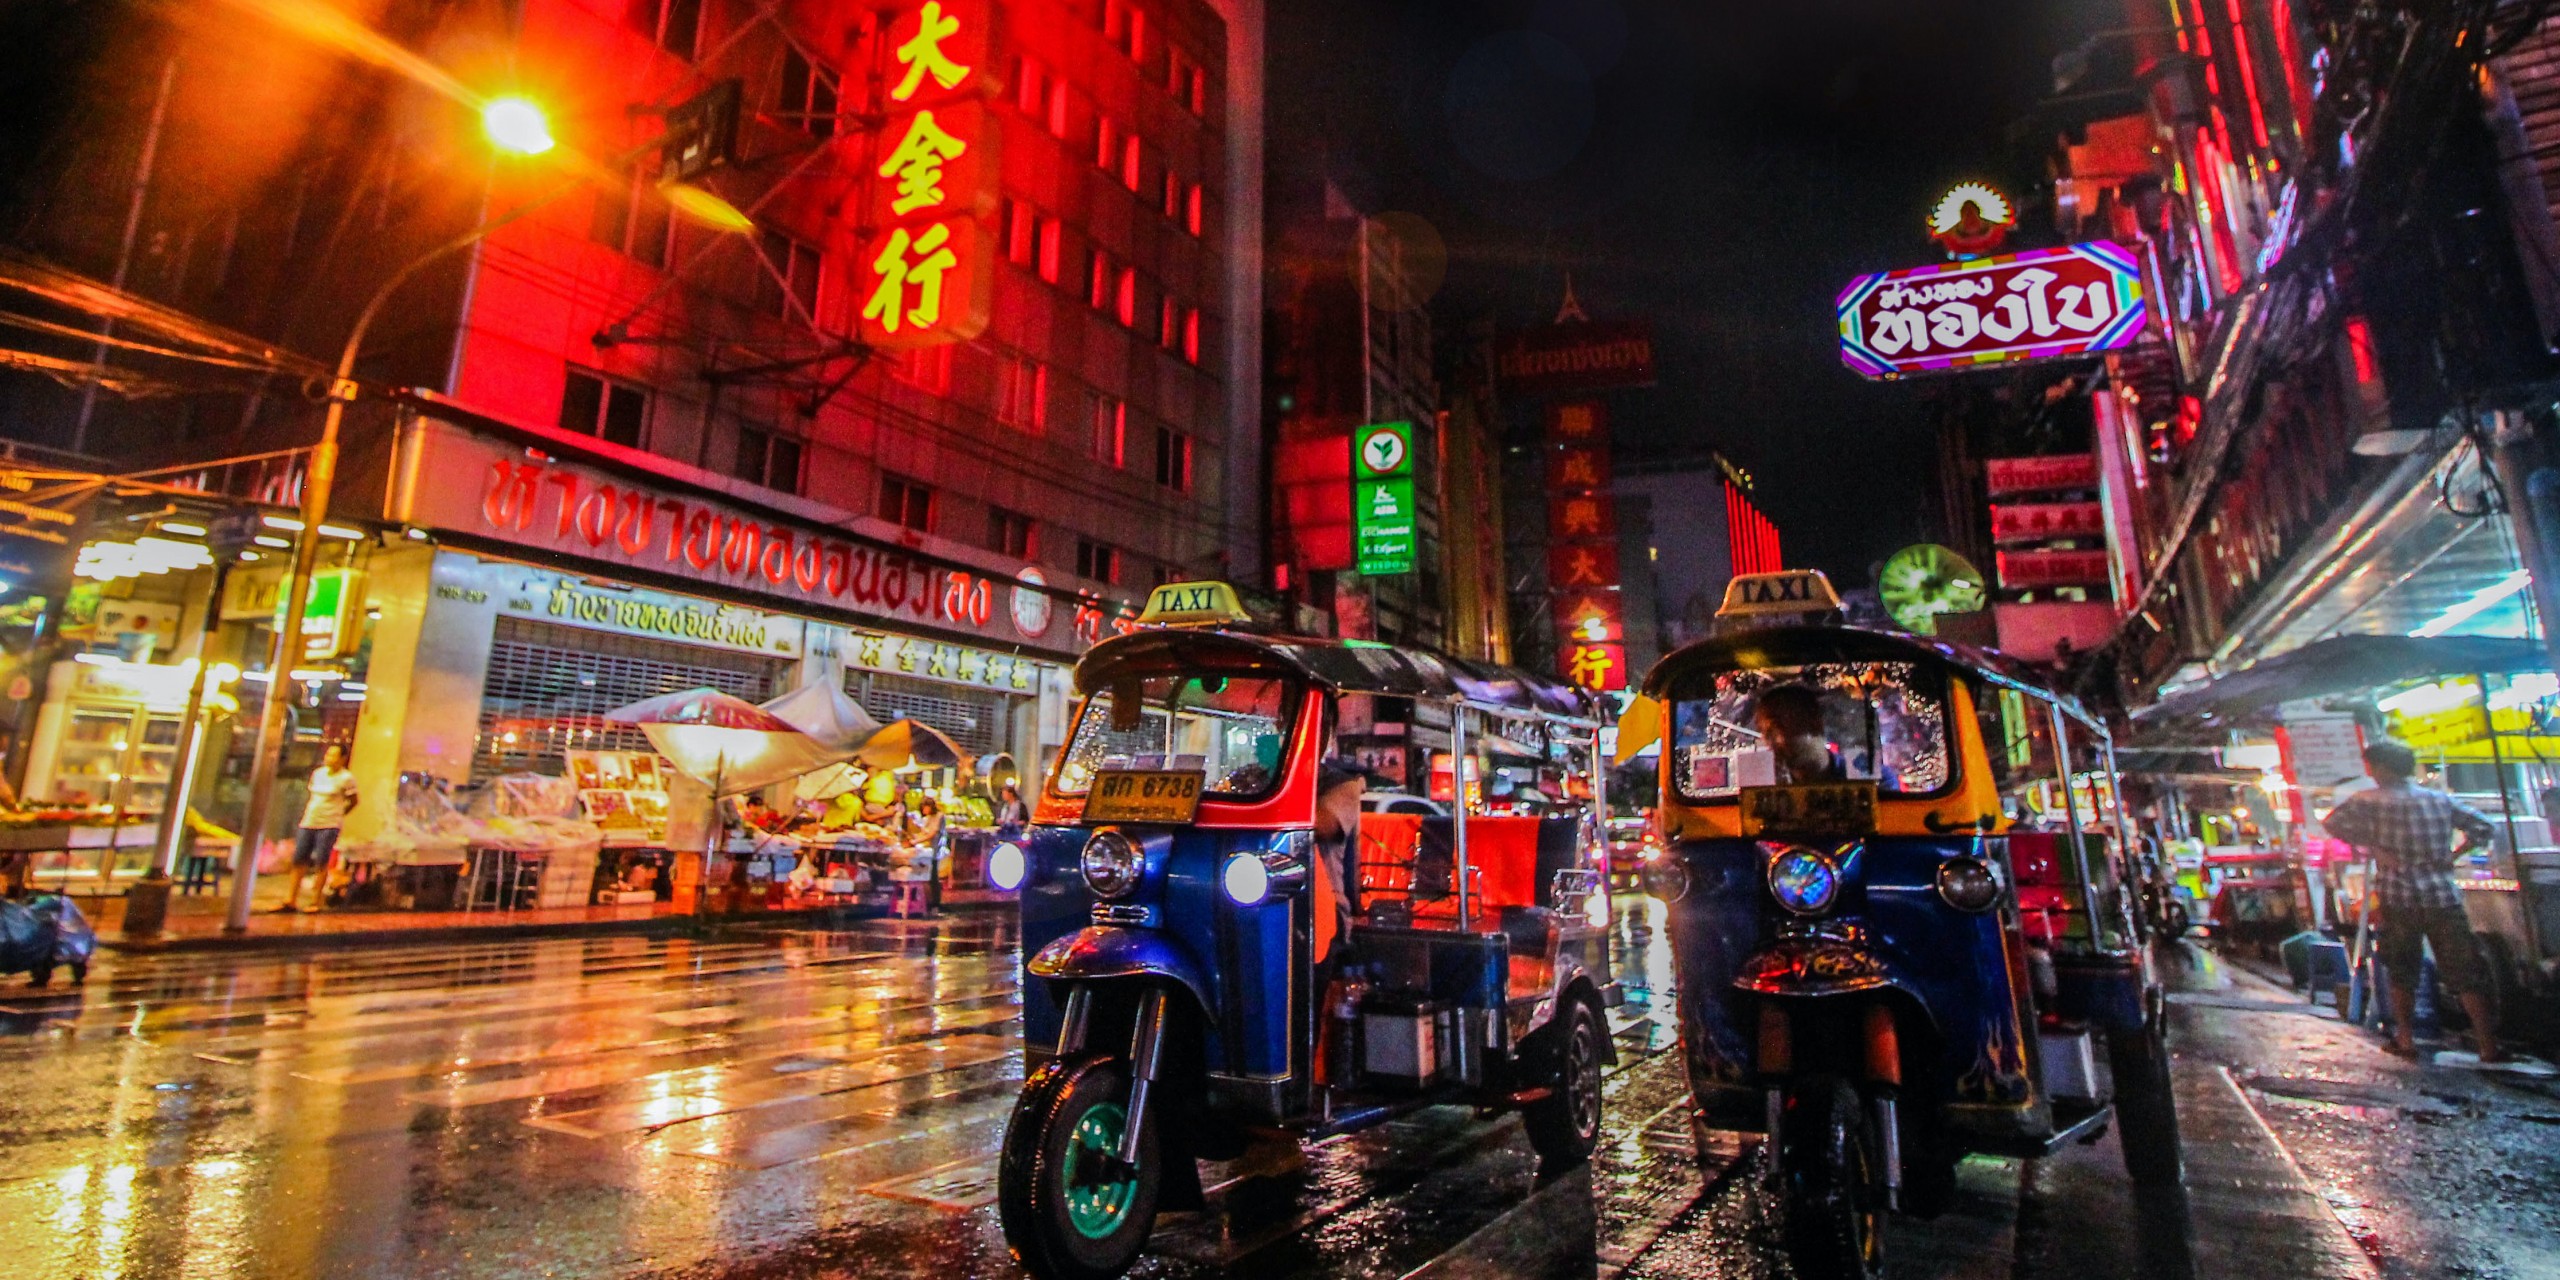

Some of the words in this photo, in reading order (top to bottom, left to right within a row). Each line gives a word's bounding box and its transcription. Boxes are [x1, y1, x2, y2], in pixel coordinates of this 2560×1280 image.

[863, 1, 971, 333] 大金行
[1870, 269, 2111, 355] ทองใบ
[1157, 587, 1214, 612] TAXI
[1741, 577, 1811, 604] TAXI
[1141, 777, 1195, 798] 6738
